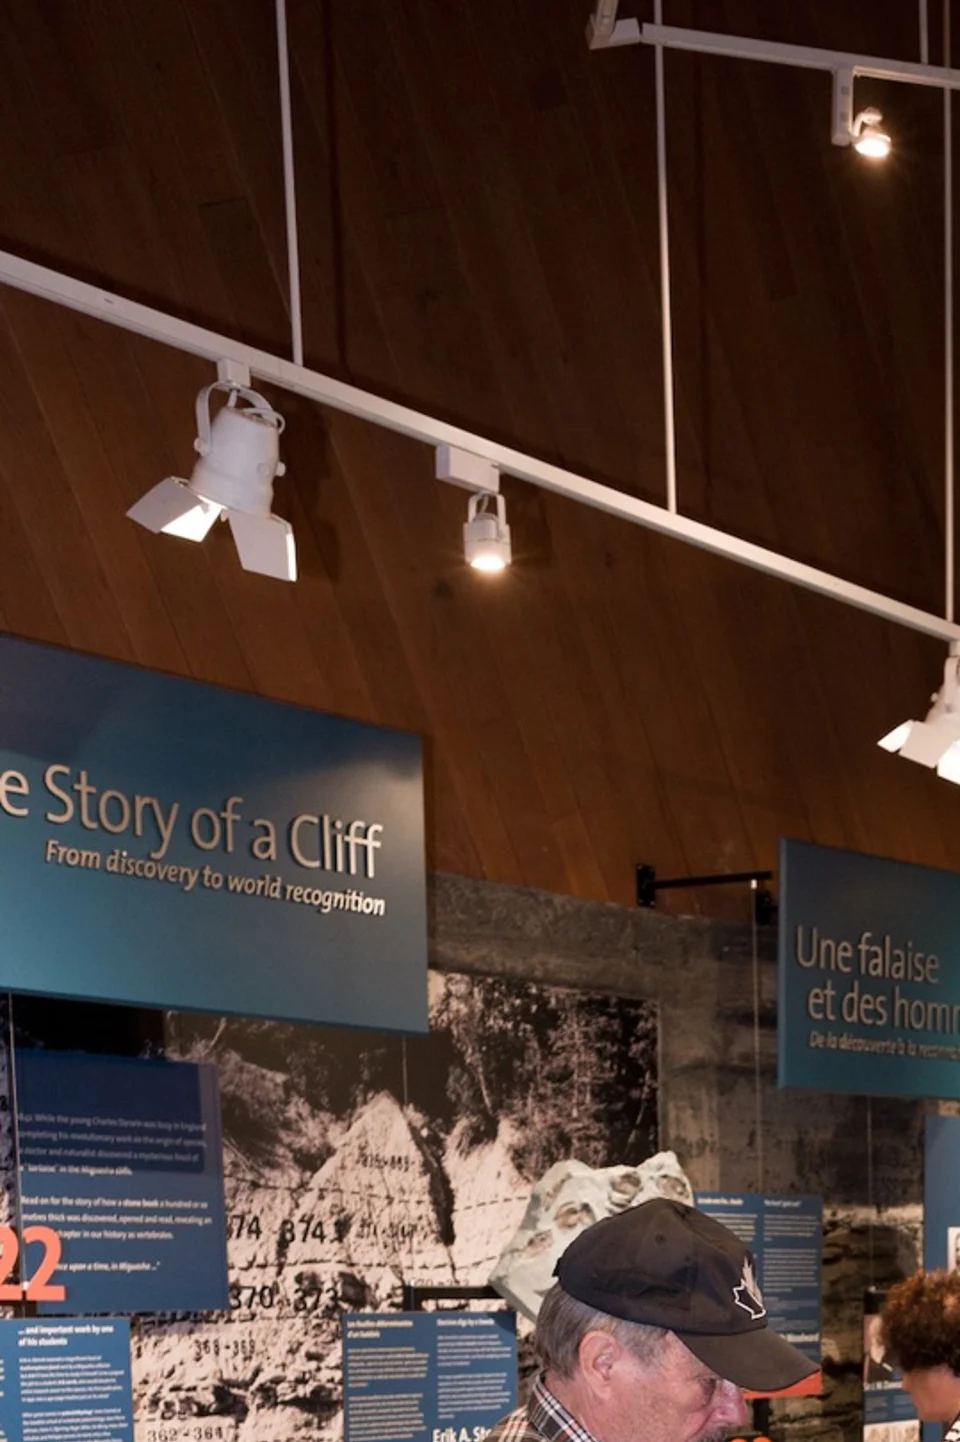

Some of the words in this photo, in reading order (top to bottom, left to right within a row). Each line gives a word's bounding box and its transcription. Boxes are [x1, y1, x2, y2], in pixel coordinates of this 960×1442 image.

[44, 764, 179, 860] Story
[191, 796, 244, 855] of
[252, 819, 277, 862] a
[290, 814, 384, 880] Cliff
[44, 840, 101, 872] From
[106, 848, 199, 893] discovery
[203, 866, 223, 890] to
[227, 874, 282, 901] world
[285, 883, 386, 917] recognition
[796, 924, 852, 973] Une
[858, 931, 940, 984] falaise
[808, 982, 836, 1021] et
[842, 980, 887, 1026] des
[809, 1031, 824, 1048] De
[826, 1033, 838, 1050] la
[62, 1197, 75, 1206] the
